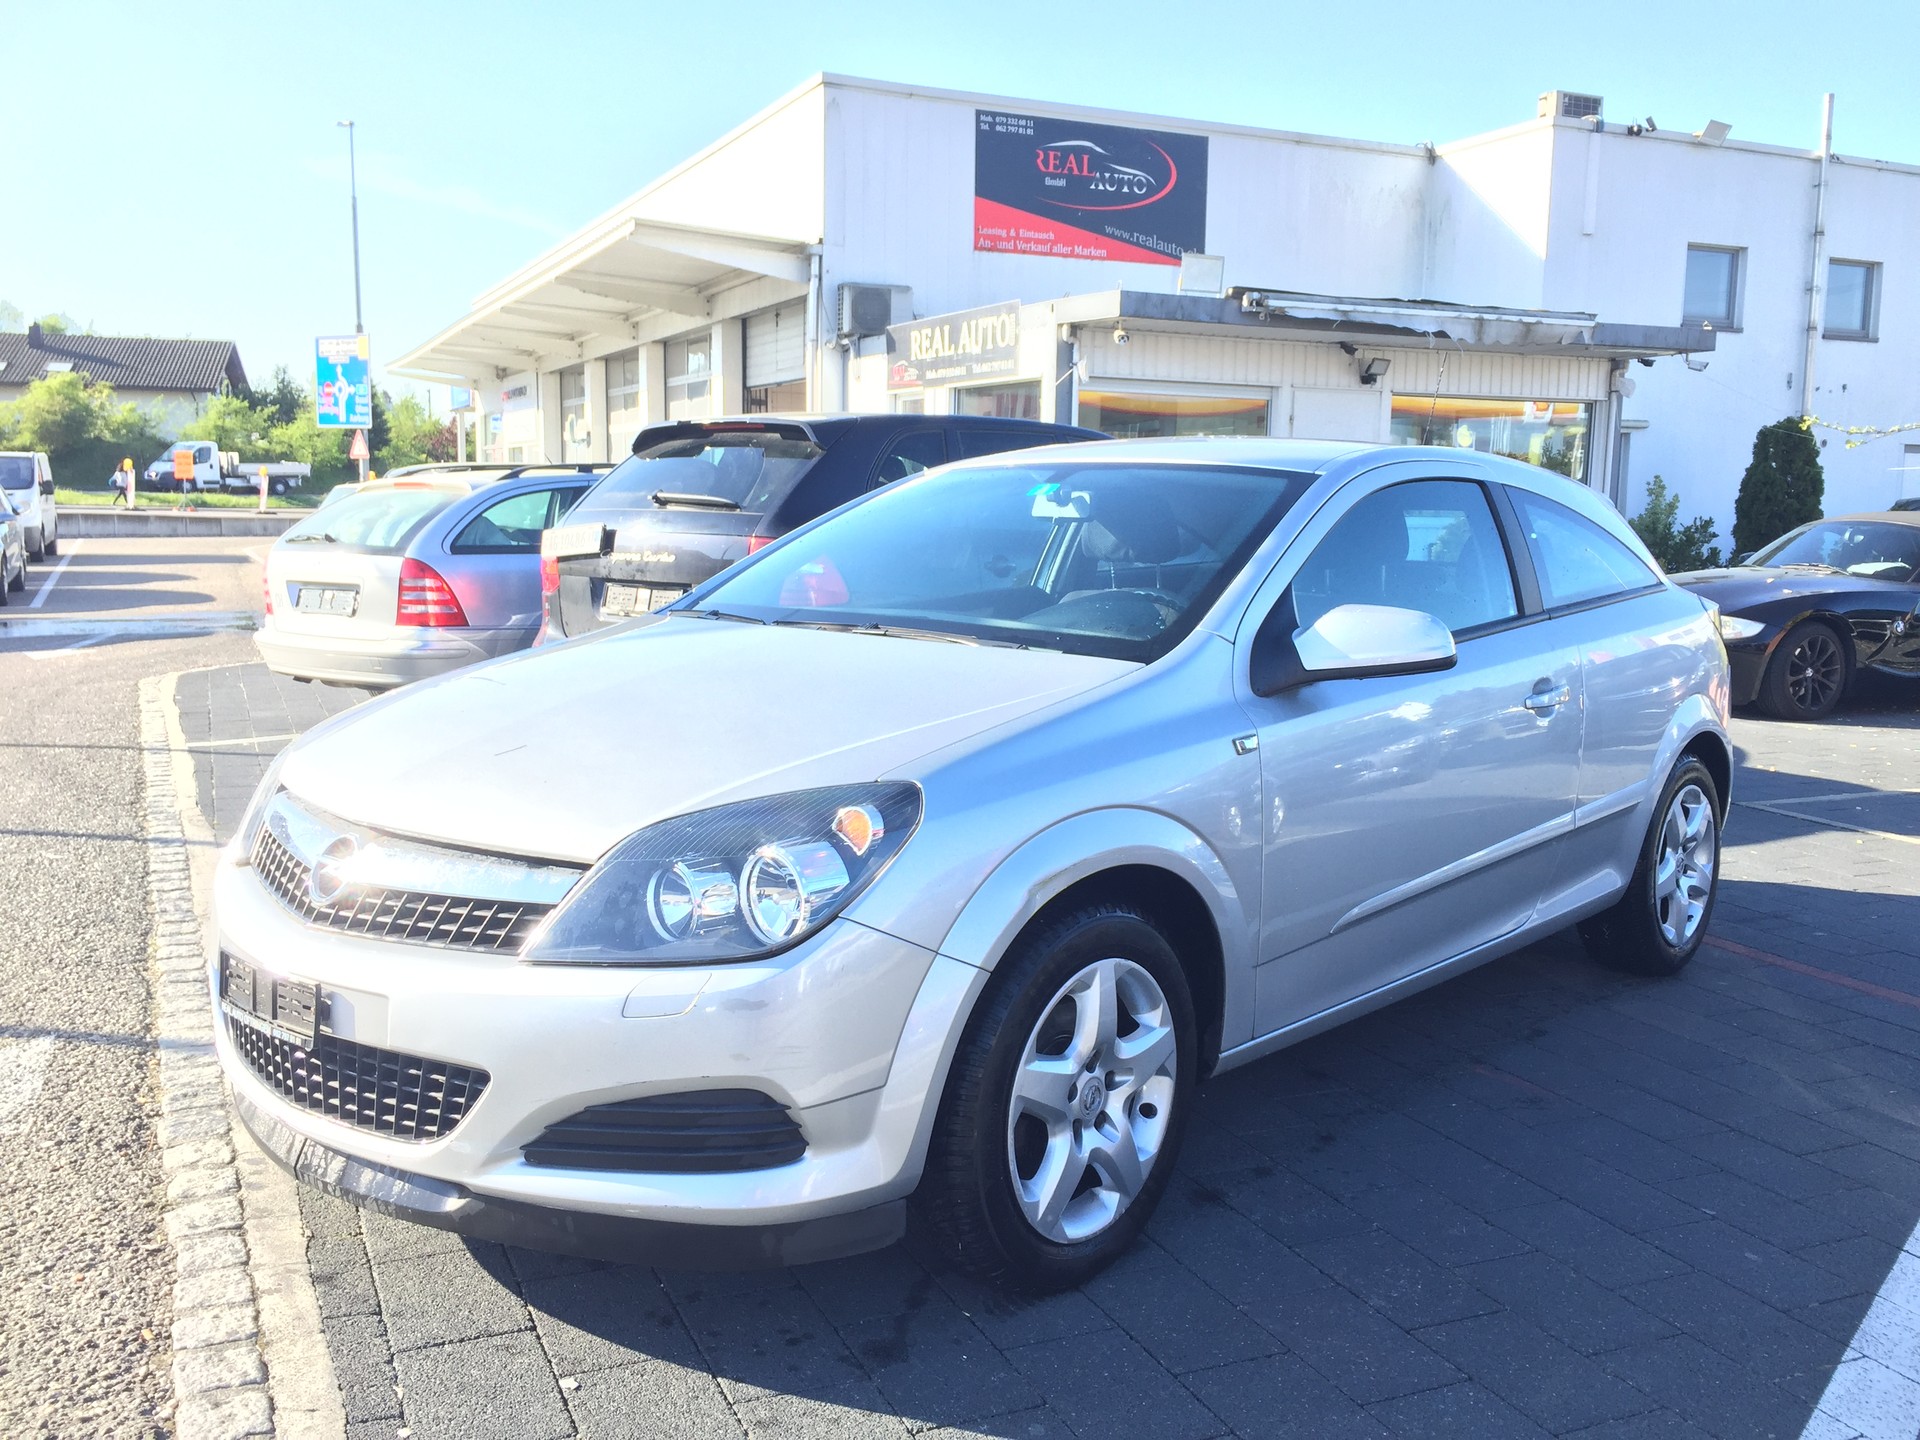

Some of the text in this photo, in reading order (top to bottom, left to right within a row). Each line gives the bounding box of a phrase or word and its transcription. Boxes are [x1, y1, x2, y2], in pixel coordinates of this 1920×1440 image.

[995, 124, 1006, 132] 062
[1036, 149, 1148, 194] REAL AUTO
[1044, 176, 1067, 188] GmbH
[978, 226, 1055, 240] Leasing & Eintausch
[1104, 224, 1199, 256] www.realauto
[977, 237, 1107, 257] An- und Verkauf aller Marken
[910, 325, 955, 361] REAL
[957, 313, 1009, 354] AUTO
